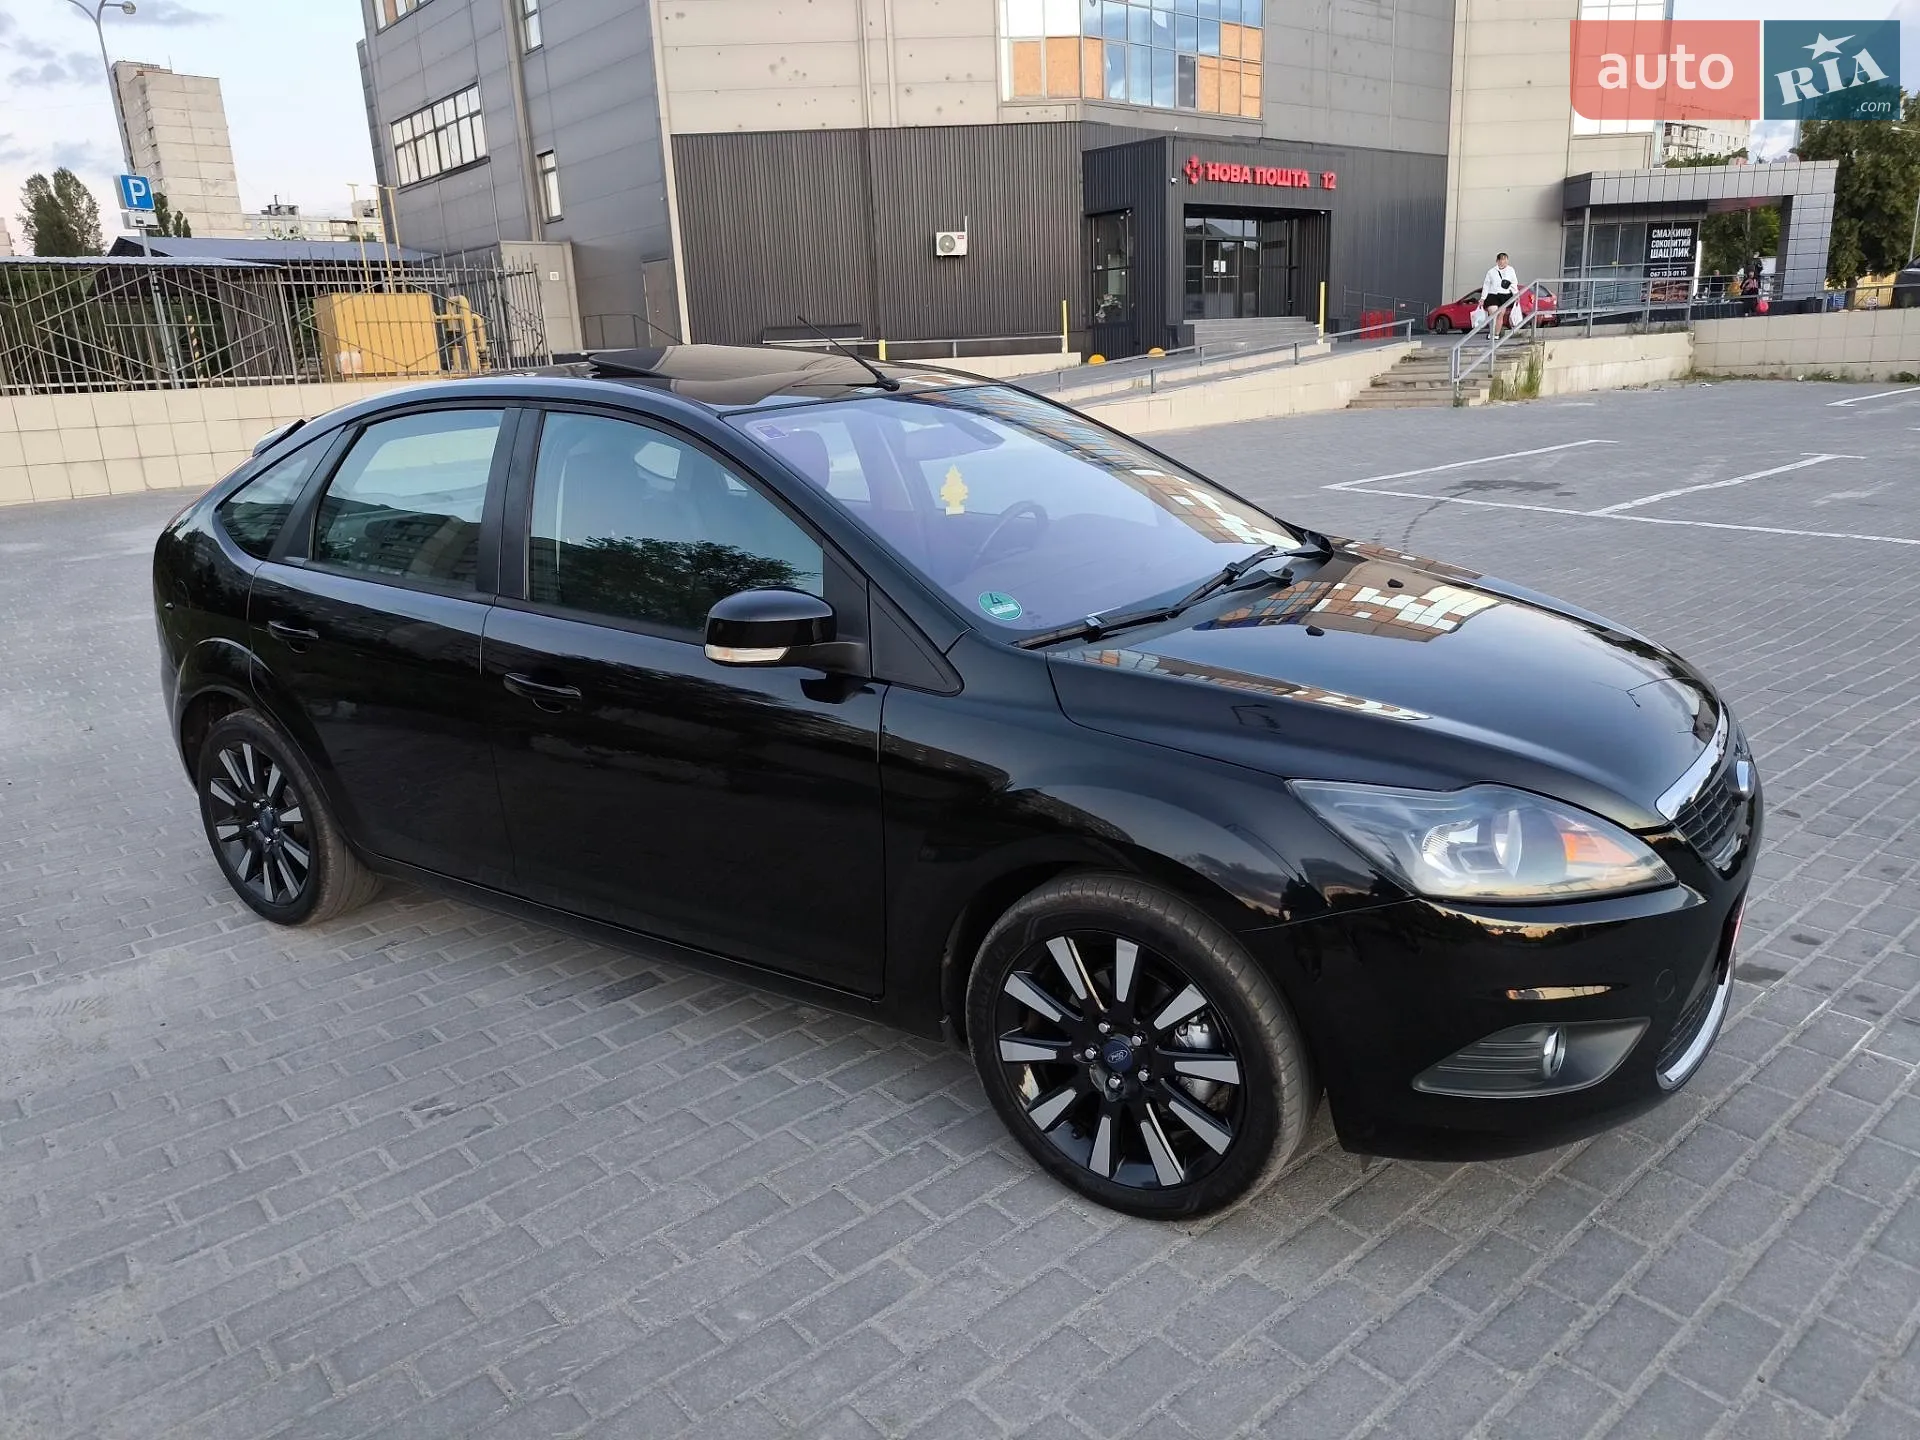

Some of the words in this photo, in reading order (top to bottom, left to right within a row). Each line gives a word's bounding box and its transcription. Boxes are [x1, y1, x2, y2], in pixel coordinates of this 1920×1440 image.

[1206, 162, 1251, 184] НОВА
[1253, 167, 1310, 188] ПОШТА
[1321, 171, 1337, 190] 12
[127, 179, 146, 205] P
[1652, 228, 1692, 239] СМАЖИМО
[1650, 248, 1690, 259] ШАШЛИК
